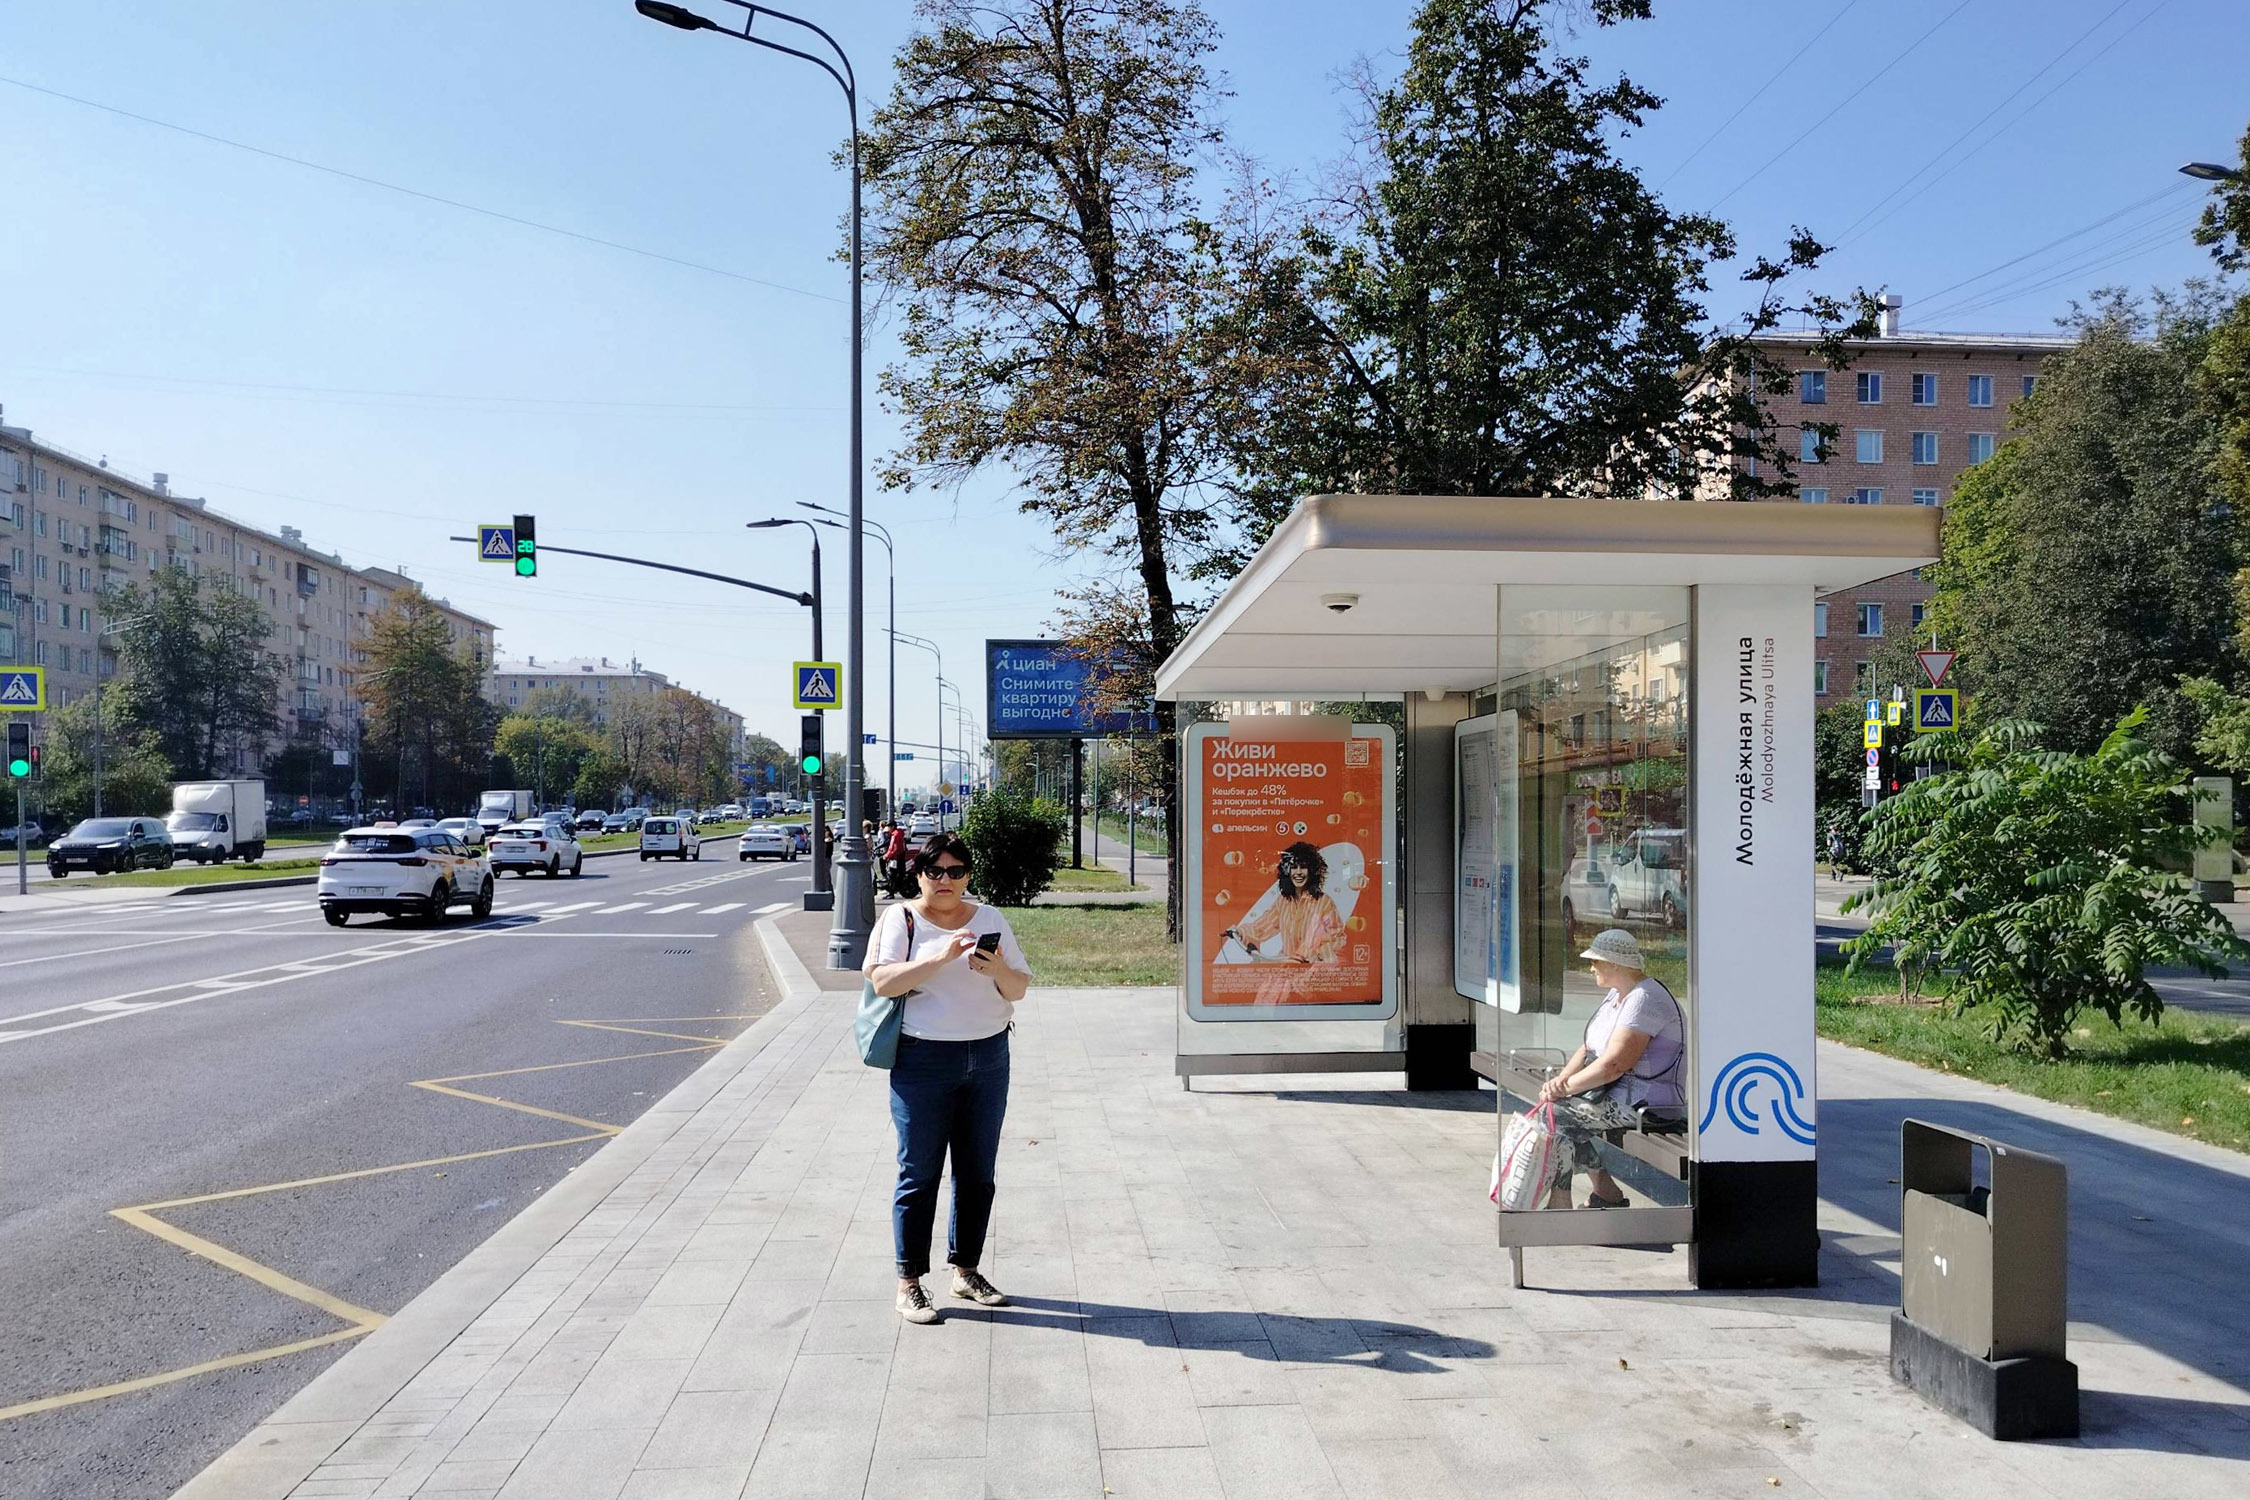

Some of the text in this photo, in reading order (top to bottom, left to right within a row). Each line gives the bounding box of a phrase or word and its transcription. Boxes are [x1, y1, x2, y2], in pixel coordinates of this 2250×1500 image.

[517, 539, 534, 553] 28
[1013, 659, 1056, 672] циан
[1001, 677, 1074, 690] Снимите
[1001, 694, 1077, 707] квартиру
[1761, 637, 1776, 803] Molodyozhnaya Ulitsa
[1212, 740, 1276, 759] Живи
[1735, 637, 1757, 866] Молодёжная улица
[1212, 762, 1328, 781] оранжево
[1247, 789, 1258, 797] до
[1260, 784, 1287, 796] 48%
[1212, 798, 1223, 806] за
[1224, 798, 1261, 807] покупки
[1270, 797, 1324, 807] «Пятёрочке»
[1227, 824, 1268, 832] апельсин
